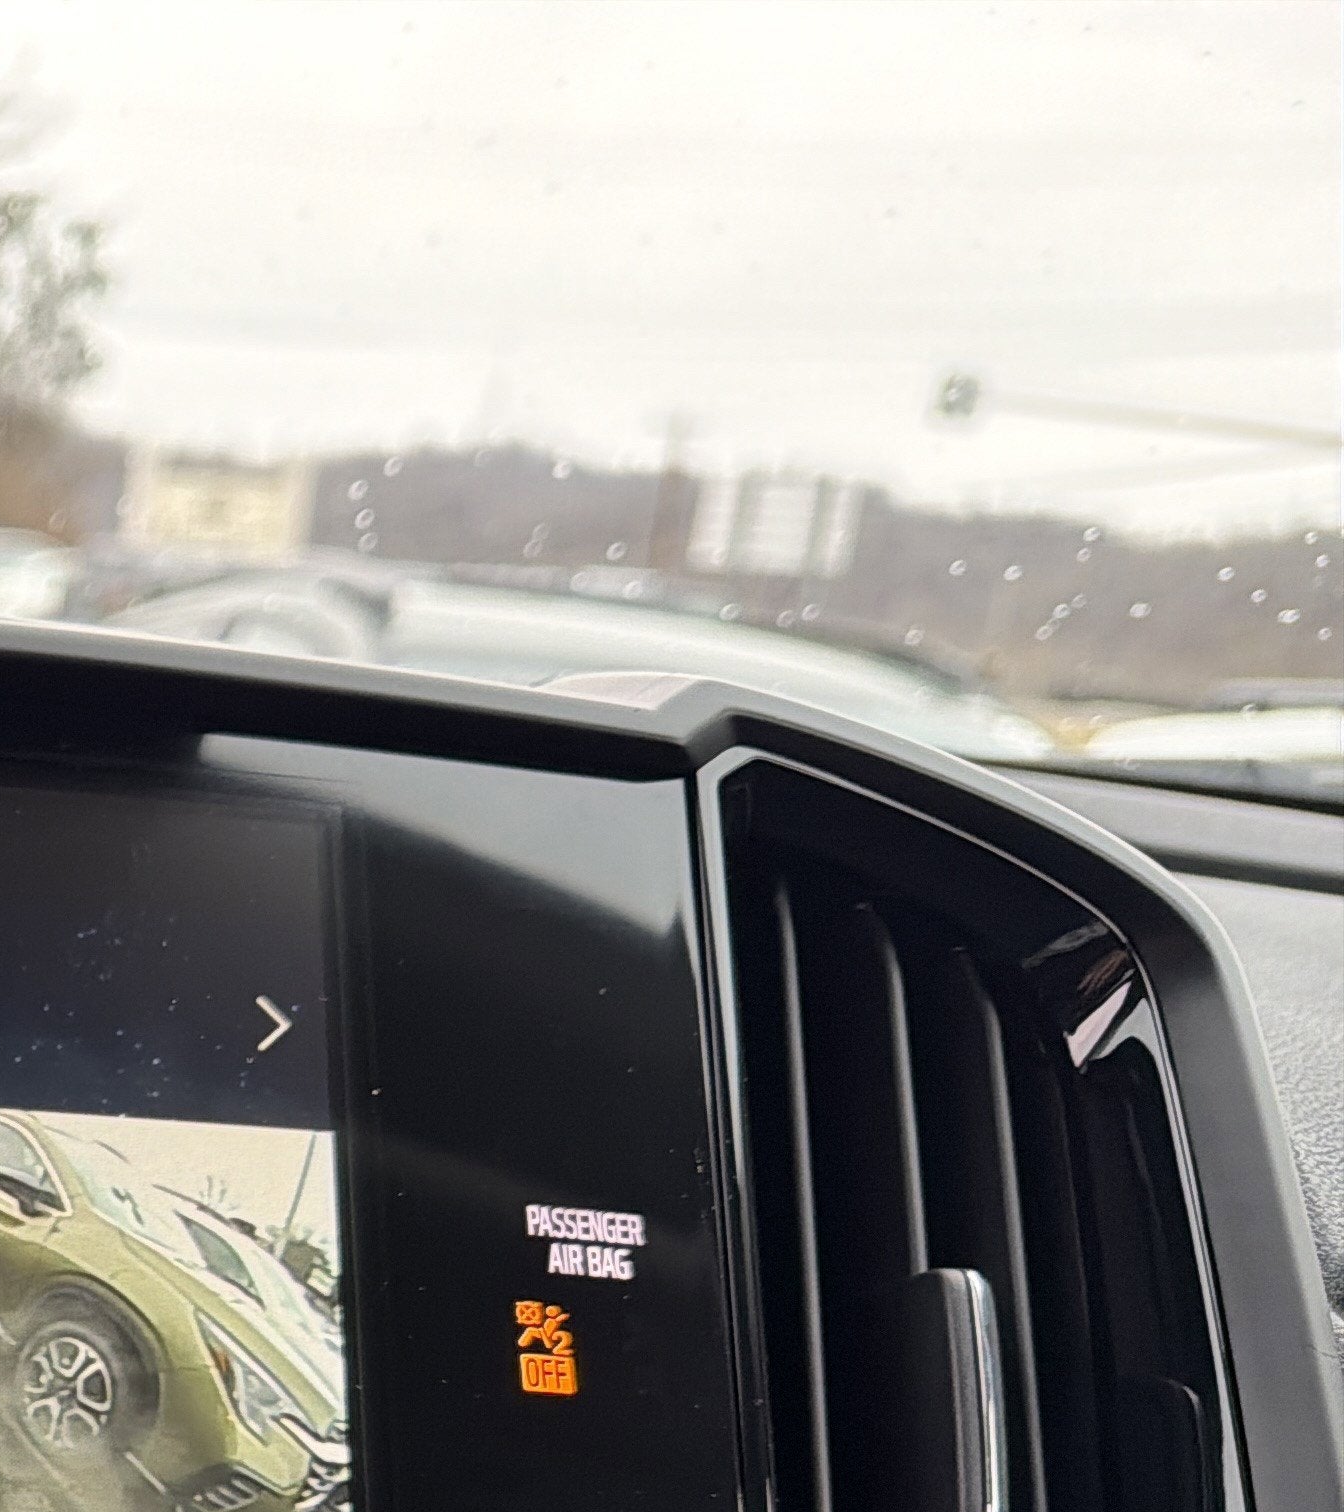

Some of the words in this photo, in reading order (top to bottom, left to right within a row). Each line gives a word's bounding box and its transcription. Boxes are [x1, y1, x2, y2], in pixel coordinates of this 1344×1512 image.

[525, 1204, 646, 1246] PASSENGER
[548, 1242, 586, 1275] AIR
[586, 1245, 635, 1281] BAG
[526, 1357, 568, 1389] OFF
